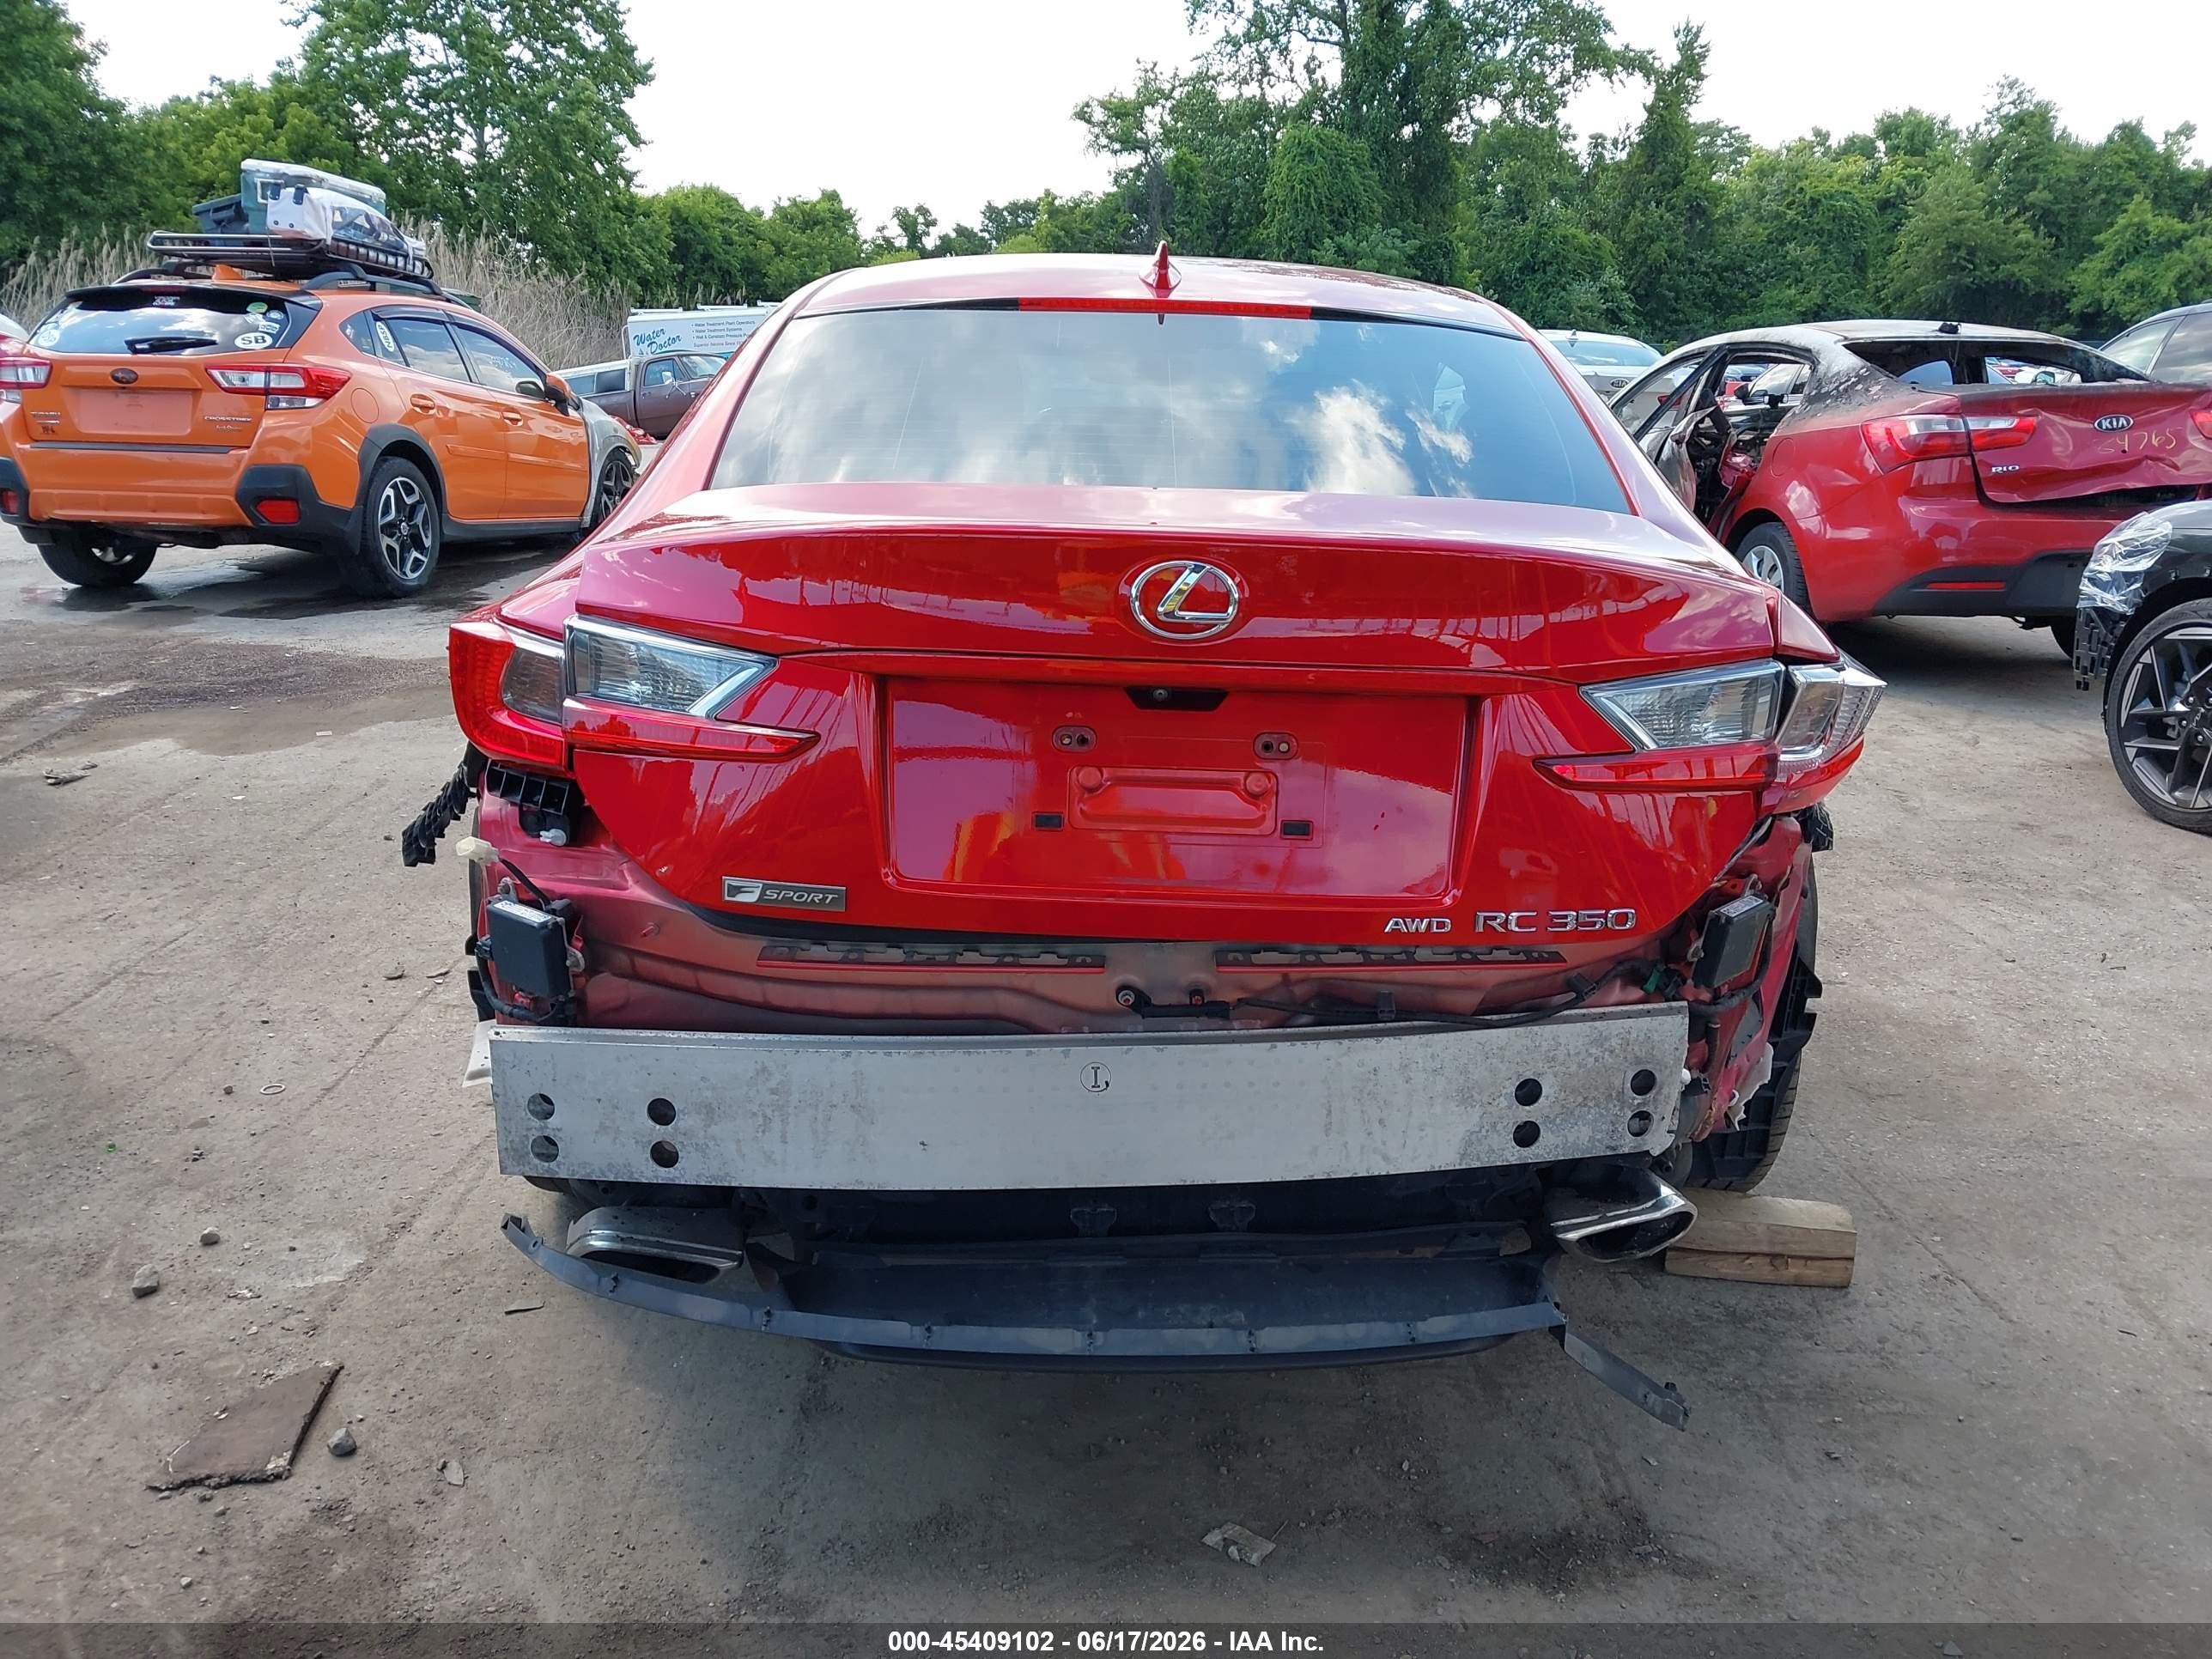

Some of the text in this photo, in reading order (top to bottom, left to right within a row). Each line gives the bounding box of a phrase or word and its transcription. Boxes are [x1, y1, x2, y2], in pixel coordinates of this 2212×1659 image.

[240, 335, 267, 345] SB
[634, 328, 665, 346] Water
[647, 335, 681, 355] Doctor
[2101, 416, 2128, 429] KIA
[1991, 465, 2020, 473] RIO
[763, 889, 839, 904] SPORT
[1383, 908, 1638, 934] AWD RC 350
